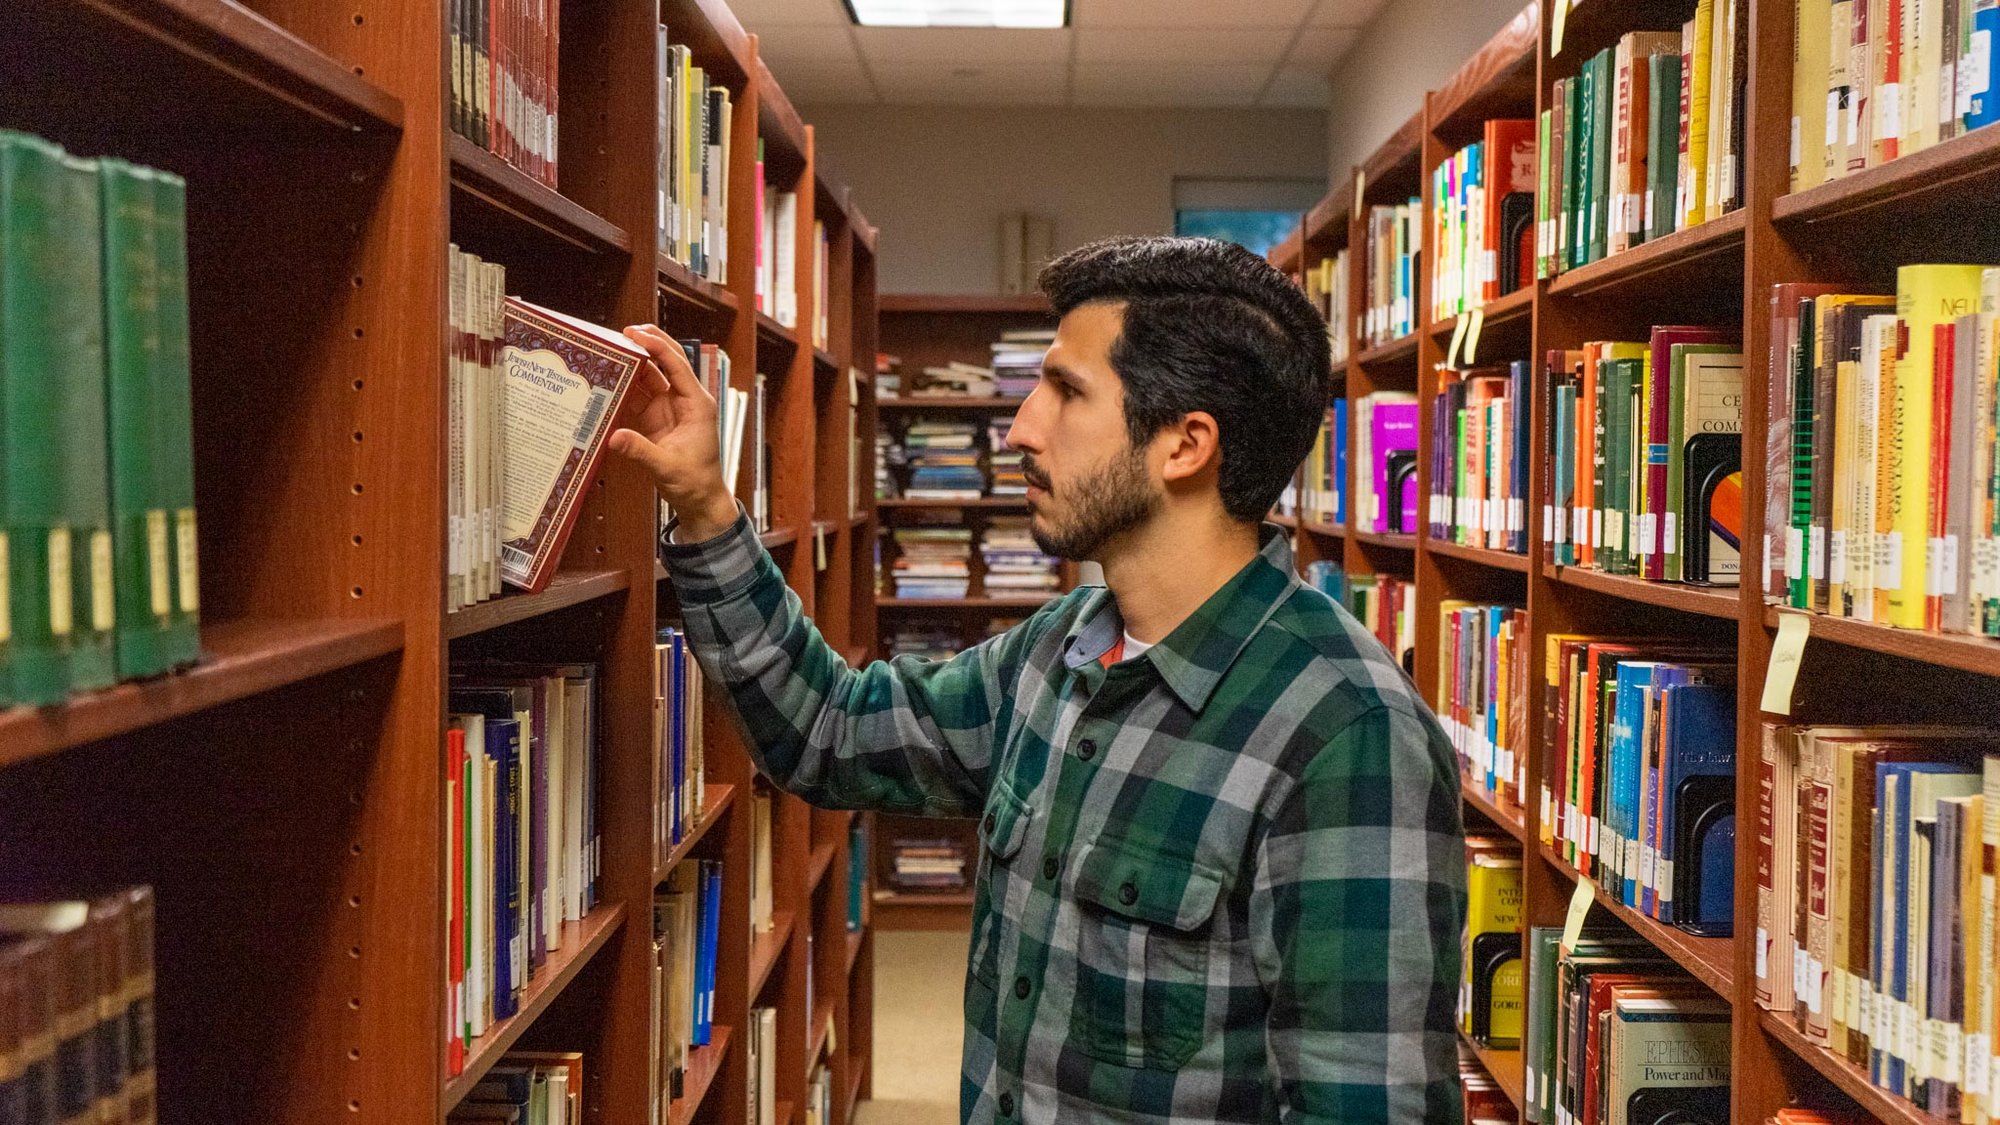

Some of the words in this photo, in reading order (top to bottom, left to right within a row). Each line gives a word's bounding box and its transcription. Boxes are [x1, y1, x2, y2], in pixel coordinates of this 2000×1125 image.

[505, 351, 531, 370] JEWISH
[527, 361, 545, 376] NEW
[545, 367, 581, 390] TESTAMENT
[509, 365, 567, 395] COMMENTARY
[1893, 384, 1906, 517] COMMENTARY
[1645, 1066, 1680, 1081] Power
[1681, 1066, 1704, 1081] and
